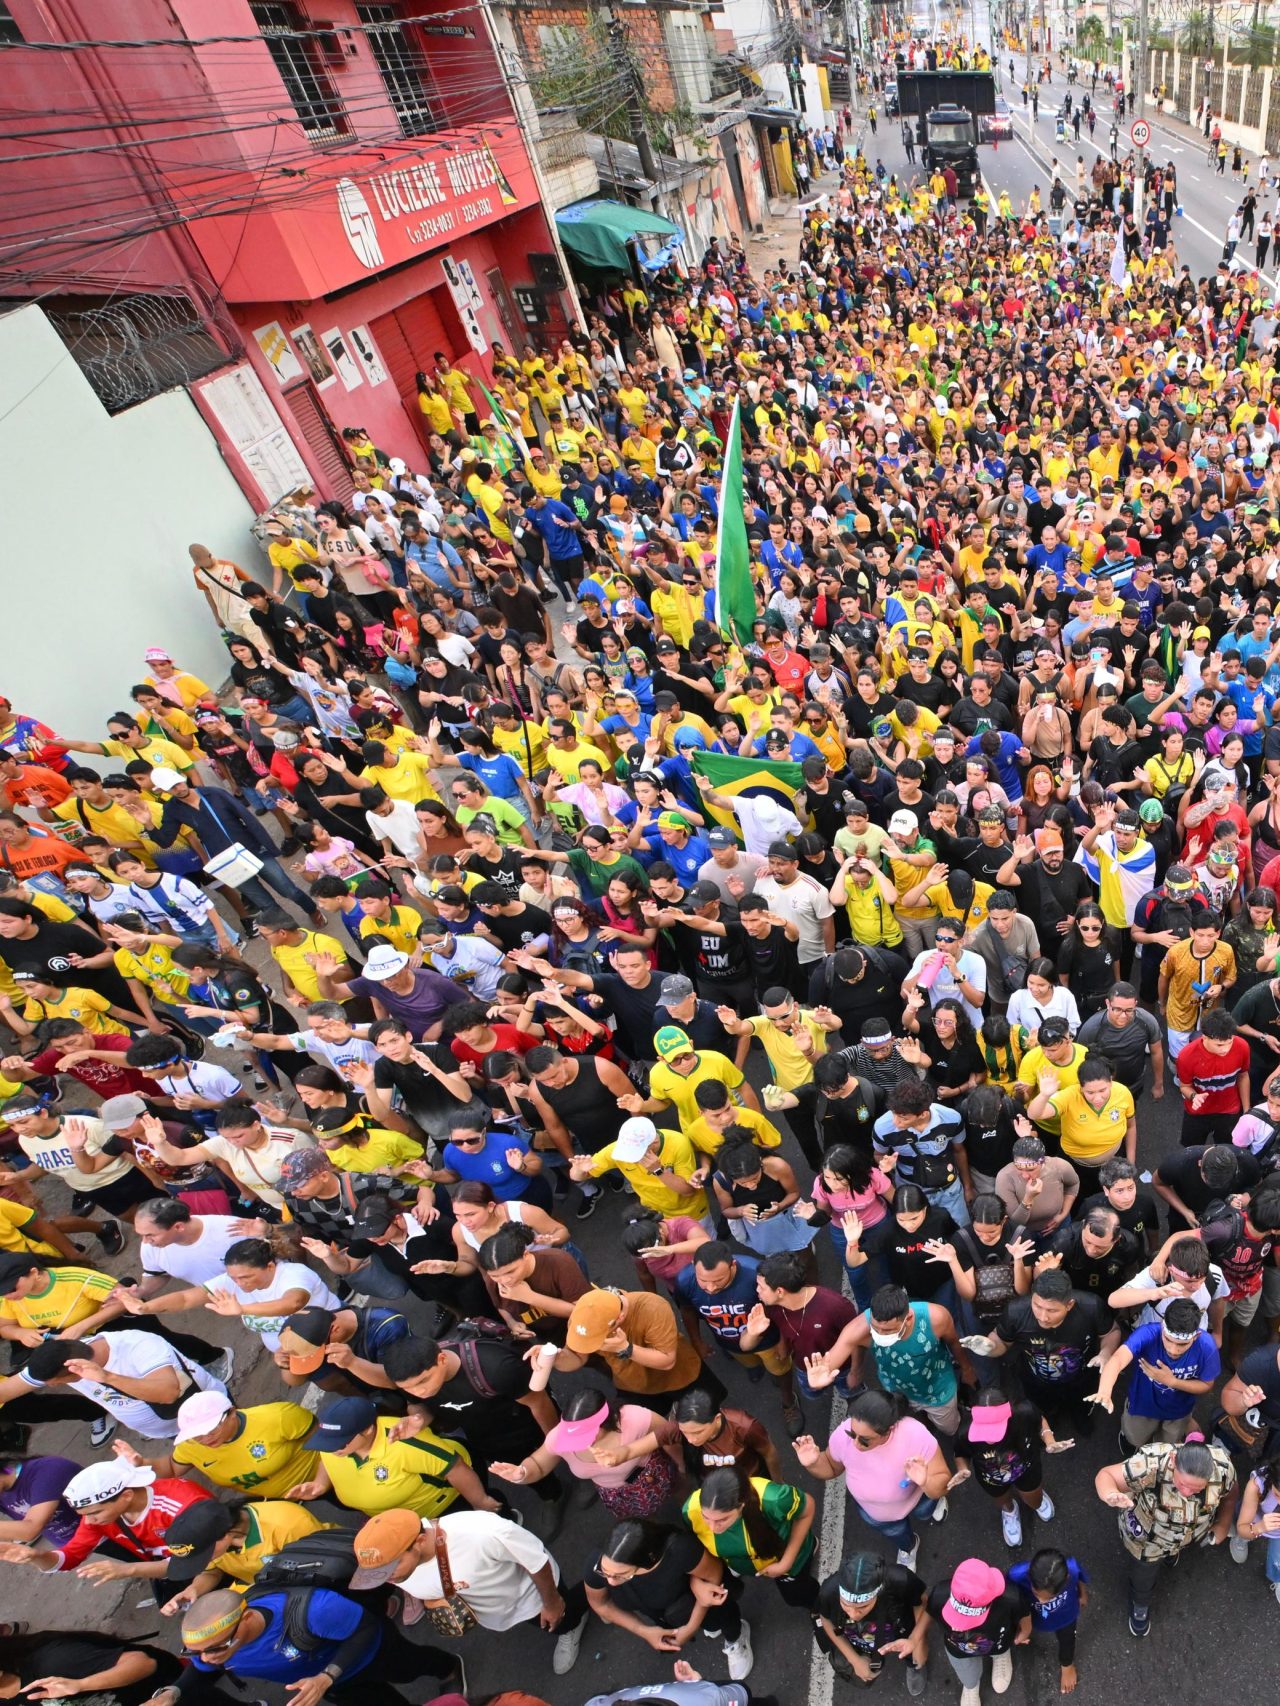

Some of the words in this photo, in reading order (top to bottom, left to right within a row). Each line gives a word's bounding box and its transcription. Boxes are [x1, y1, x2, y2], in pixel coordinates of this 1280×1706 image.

[1134, 127, 1147, 138] 40
[369, 161, 446, 221] LUCILENE
[893, 816, 908, 825] Jeep
[700, 935, 721, 951] EU
[707, 953, 730, 968] UM
[35, 1146, 74, 1171] BRAS
[1232, 1246, 1253, 1264] 10
